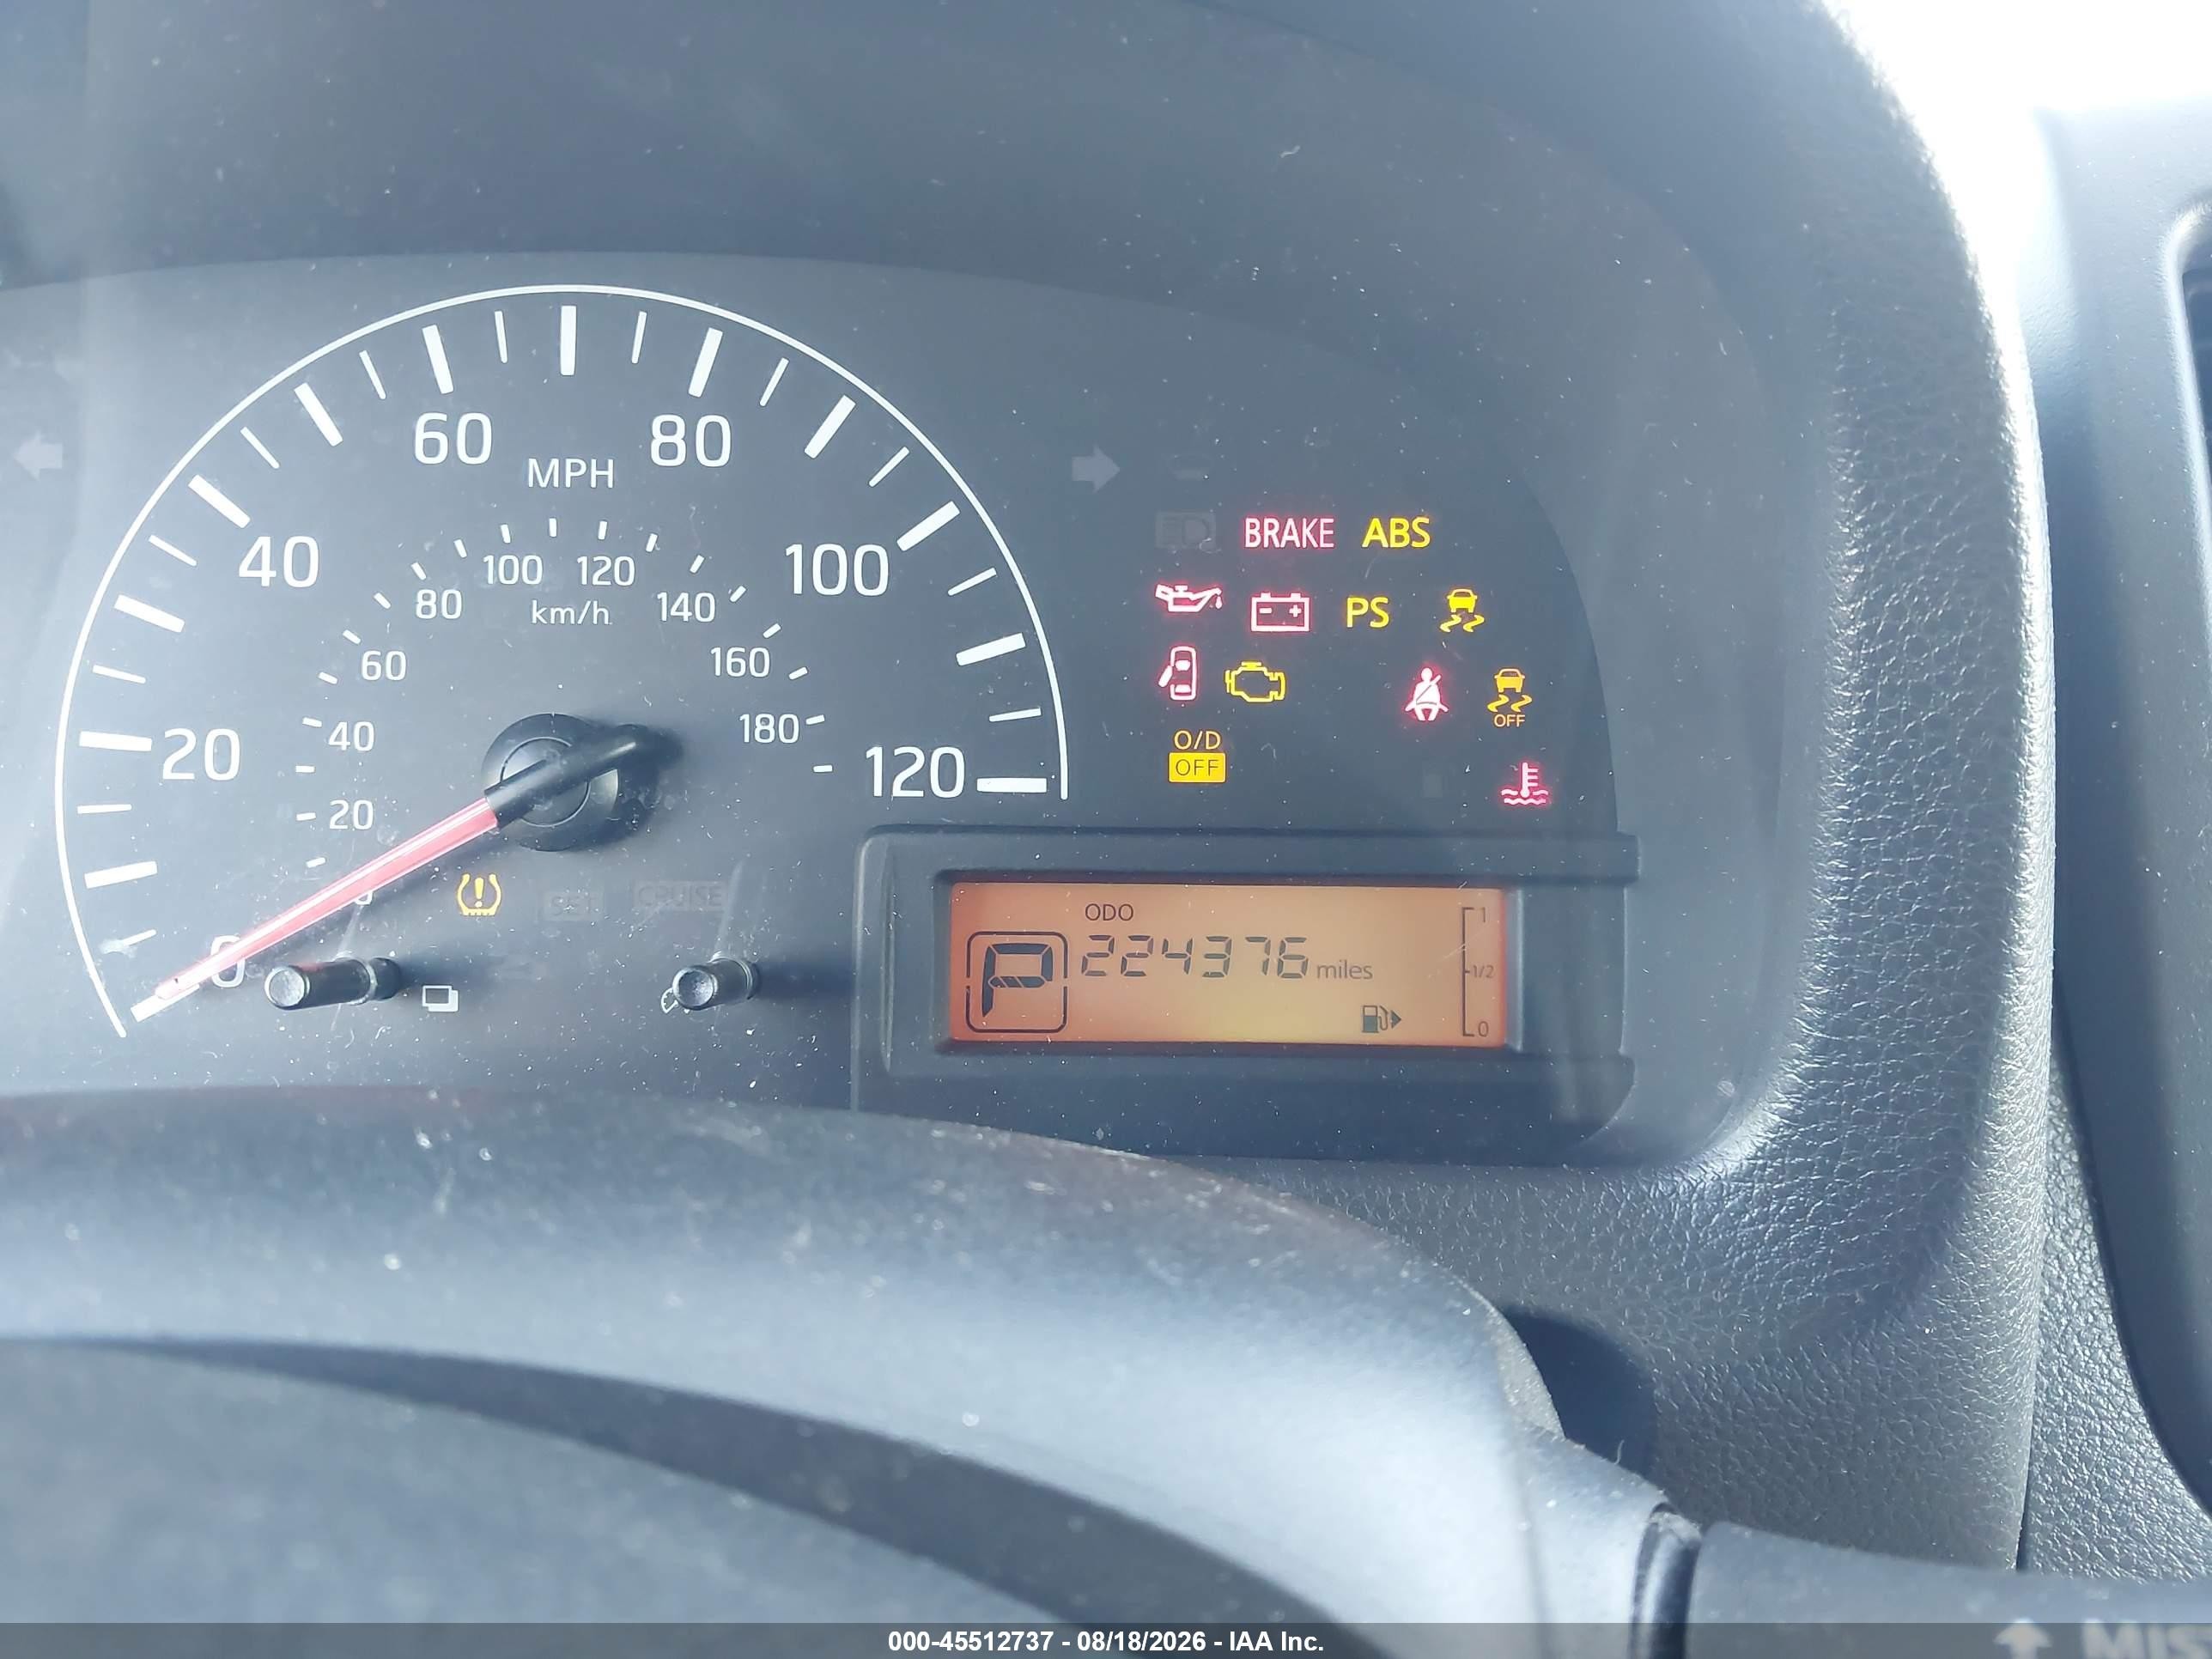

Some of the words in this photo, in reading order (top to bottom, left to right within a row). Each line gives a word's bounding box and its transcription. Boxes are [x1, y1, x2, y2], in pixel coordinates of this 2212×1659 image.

[415, 412, 492, 465] 60
[650, 414, 731, 467] 80
[528, 458, 614, 489] MPH
[1245, 517, 1334, 549] BRAKE
[1362, 516, 1431, 548] ABS
[239, 536, 319, 588] 40
[483, 555, 543, 585] 100
[576, 556, 635, 586] 120
[786, 544, 889, 596] 100
[416, 588, 462, 619] 80
[532, 599, 609, 625] km/h
[657, 592, 715, 623] 140
[1346, 596, 1389, 628] PS
[362, 650, 406, 681] 60
[710, 647, 770, 678] 160
[328, 721, 374, 751] 40
[739, 713, 799, 744] 180
[1493, 714, 1526, 727] OFF
[162, 727, 240, 781] 20
[1174, 730, 1221, 750] O/D
[866, 746, 965, 799] 120
[1175, 758, 1218, 776] OFF
[329, 799, 374, 830] 20
[1085, 902, 1134, 921] ODO
[1479, 906, 1486, 923] 1
[1080, 934, 1309, 979] 224376
[1316, 959, 1374, 980] miles
[1473, 964, 1494, 979] 1/2
[981, 942, 1054, 1018] P
[1477, 1020, 1489, 1038] 0
